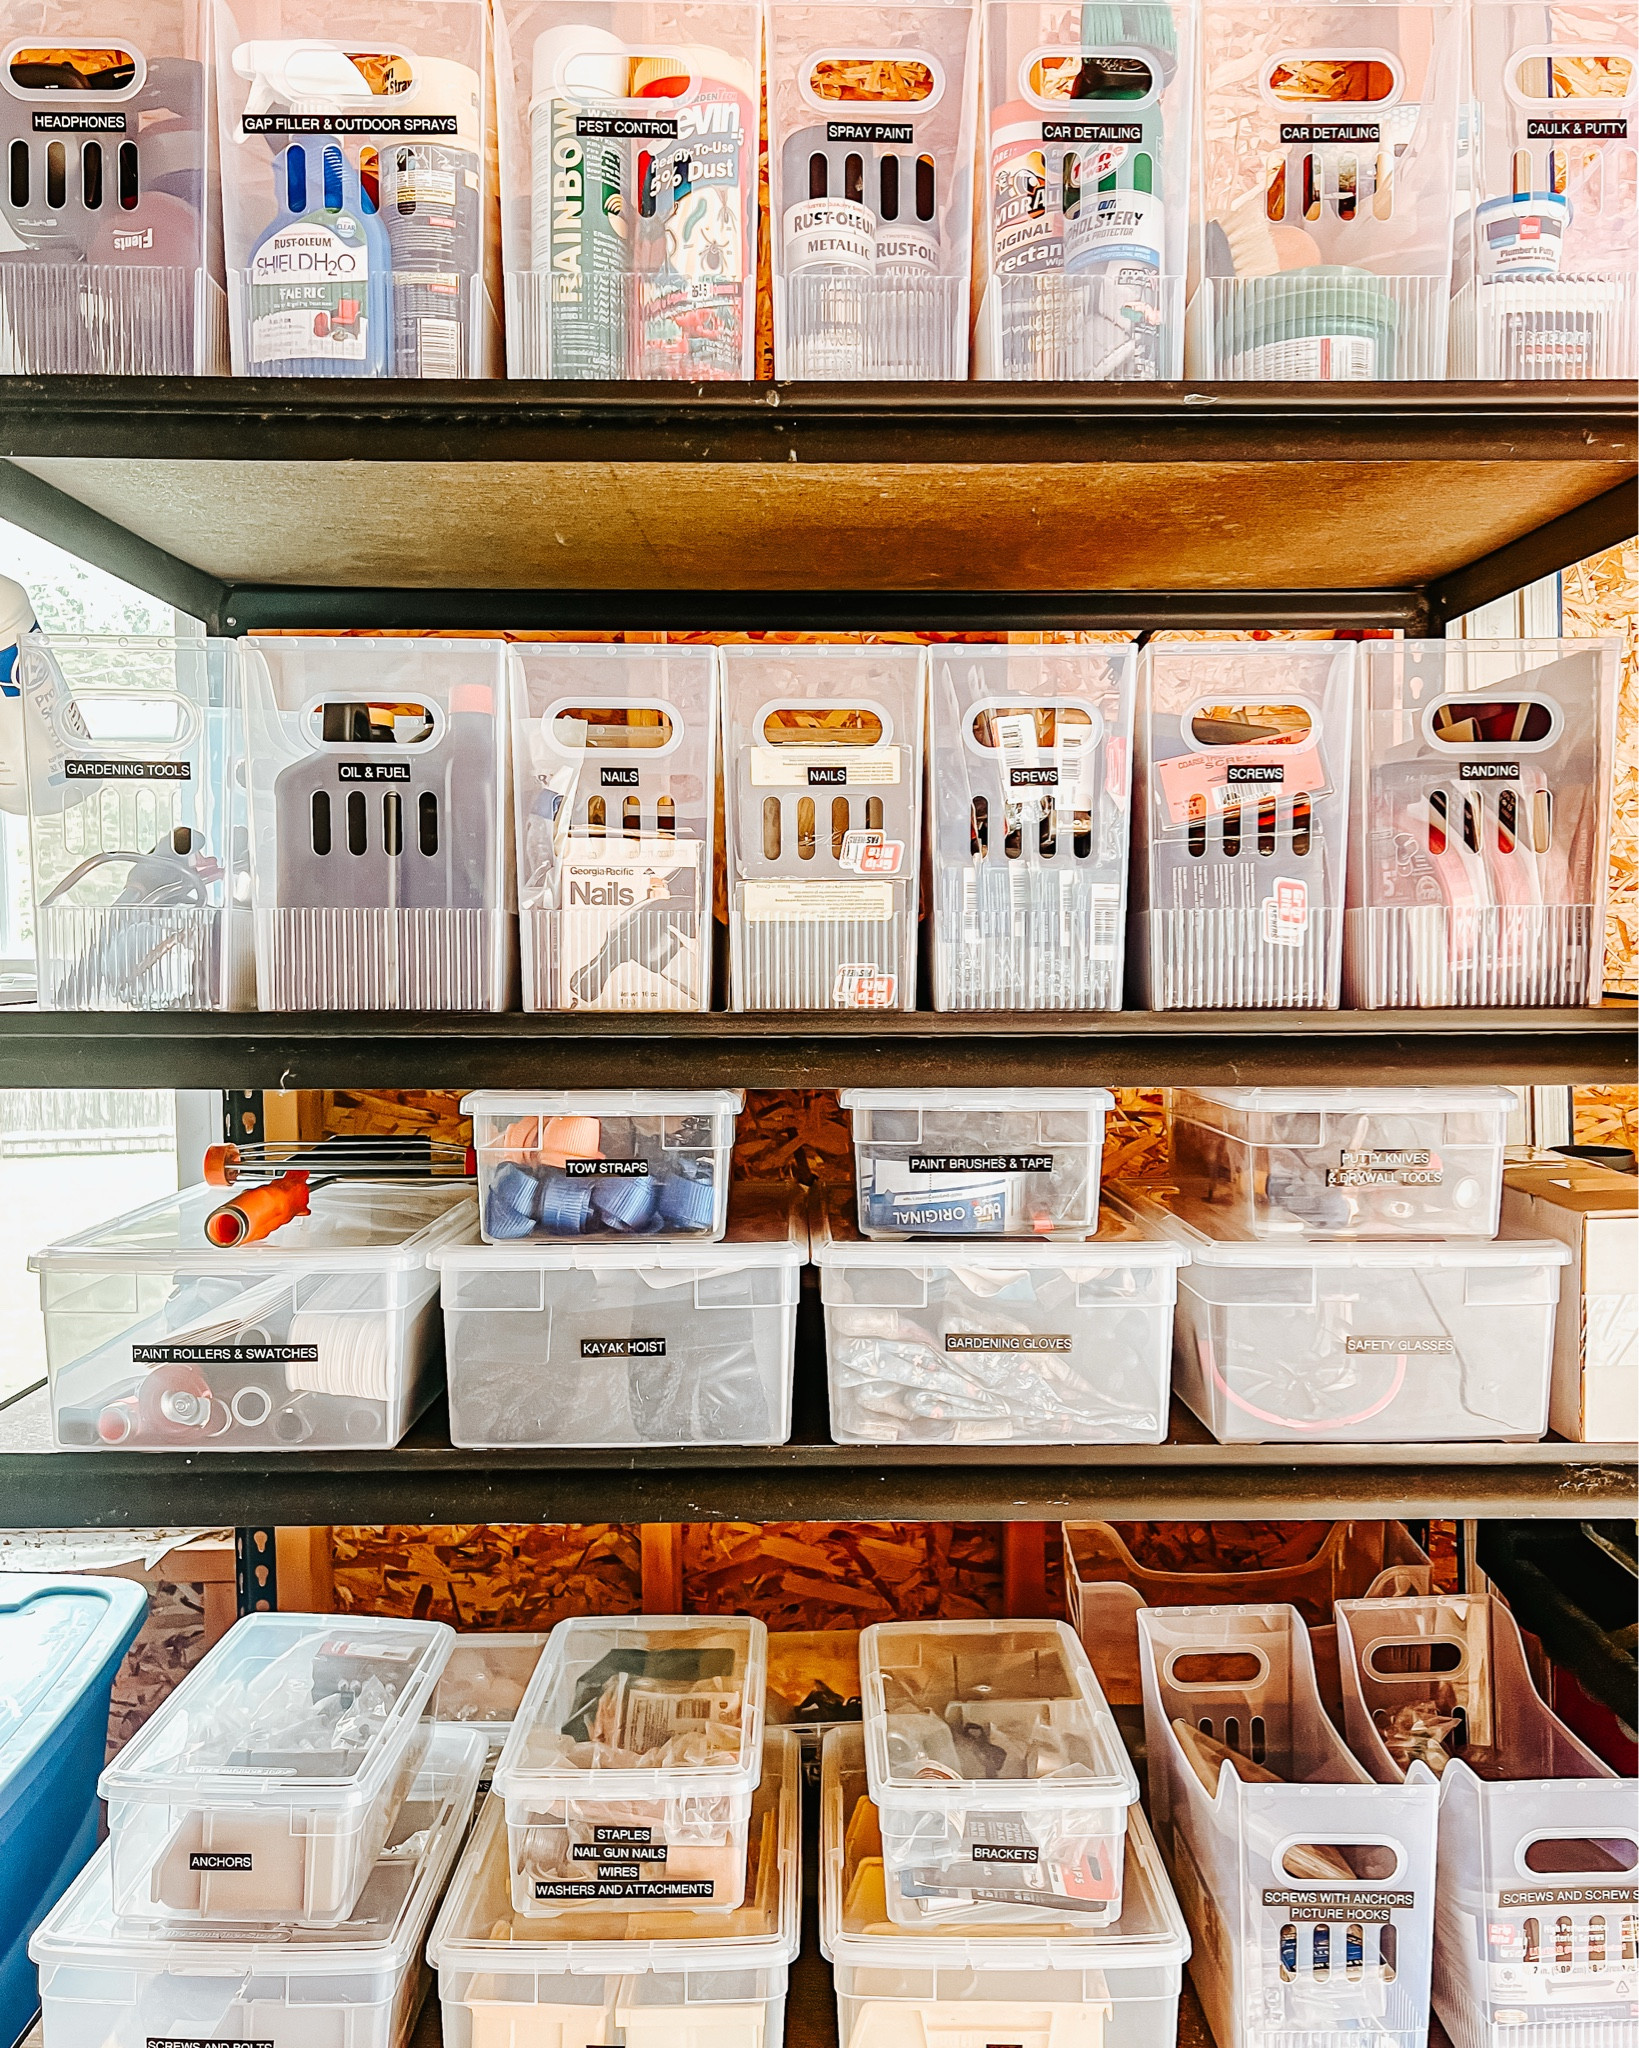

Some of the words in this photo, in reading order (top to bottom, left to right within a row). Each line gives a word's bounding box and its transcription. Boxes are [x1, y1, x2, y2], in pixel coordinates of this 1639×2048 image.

[35, 115, 125, 128] HEADPHONES
[245, 118, 272, 130] GAP
[276, 118, 319, 130] FILLER
[323, 119, 332, 130] &
[336, 118, 400, 130] OUTDOOR
[404, 118, 456, 130] SPRAYS
[578, 120, 611, 132] PEST
[614, 121, 677, 135] CONTROL
[828, 124, 867, 138] SPRAY
[870, 127, 913, 140] PAINT
[1044, 125, 1071, 138] CAR
[1074, 126, 1141, 139] DETAILING
[1282, 127, 1309, 139] CAR
[1312, 126, 1379, 138] DETAILING
[1528, 122, 1570, 135] CAULK
[1573, 123, 1582, 135] &
[1585, 122, 1627, 135] PUTTY
[687, 159, 734, 182] Dust
[274, 237, 332, 249] RUST-OLEUM
[808, 239, 870, 261] METALLIC
[67, 763, 143, 775] GARDENING
[148, 765, 190, 776] TOOLS
[340, 767, 362, 778] OIL
[365, 767, 373, 778] &
[376, 767, 409, 778] FUEL
[1229, 767, 1283, 779] SCREWS
[1462, 765, 1519, 777] SANDING
[602, 771, 638, 782] NAILS
[810, 770, 845, 782] NAILS
[1012, 771, 1058, 783] SREWS
[570, 867, 634, 876] Georgia-Pacific
[570, 881, 634, 906] Nails
[911, 1159, 946, 1170] PAINT
[950, 1158, 1007, 1170] BRUSHES
[1010, 1158, 1018, 1169] &
[1020, 1158, 1052, 1169] TAPE
[1342, 1152, 1384, 1164] PUTTY
[1386, 1152, 1429, 1164] KNIVES
[567, 1162, 596, 1174] TOW
[599, 1162, 648, 1174] STRAPS
[1340, 1172, 1397, 1183] DRYWALL
[1401, 1172, 1442, 1183] TOOLS
[893, 1206, 966, 1225] ORIGINAL
[583, 1342, 624, 1354] KAYAK
[627, 1341, 665, 1353] HOIST
[947, 1337, 1020, 1349] GARDENING
[1023, 1338, 1072, 1349] GLOVES
[1348, 1340, 1395, 1351] SAFETY
[1398, 1340, 1454, 1351] GLASSES
[133, 1347, 170, 1359] PAINT
[173, 1348, 231, 1359] ROLLERS
[234, 1347, 243, 1359] &
[245, 1347, 317, 1359] SWATCHES
[597, 1829, 650, 1841] STAPLES
[573, 1847, 600, 1858] NAIL
[603, 1847, 629, 1859] GUN
[632, 1847, 666, 1859] NAILS
[974, 1847, 1038, 1860] BRACKETS
[191, 1855, 251, 1868] ANCHORS
[599, 1866, 638, 1877] WIRES
[536, 1884, 595, 1896] WASHERS
[598, 1884, 623, 1895] AND
[625, 1883, 712, 1895] ATTACHMENTS
[1265, 1892, 1316, 1903] SCREWS
[1320, 1893, 1350, 1903] WITH
[1354, 1893, 1413, 1905] ANCHORS
[1503, 1891, 1553, 1904] SCREWS
[1557, 1890, 1582, 1901] AND
[1585, 1889, 1629, 1900] SCREW
[1291, 1908, 1343, 1919] PICTURE
[1347, 1909, 1390, 1920] HOOKS
[148, 2040, 200, 2048] SCREWS
